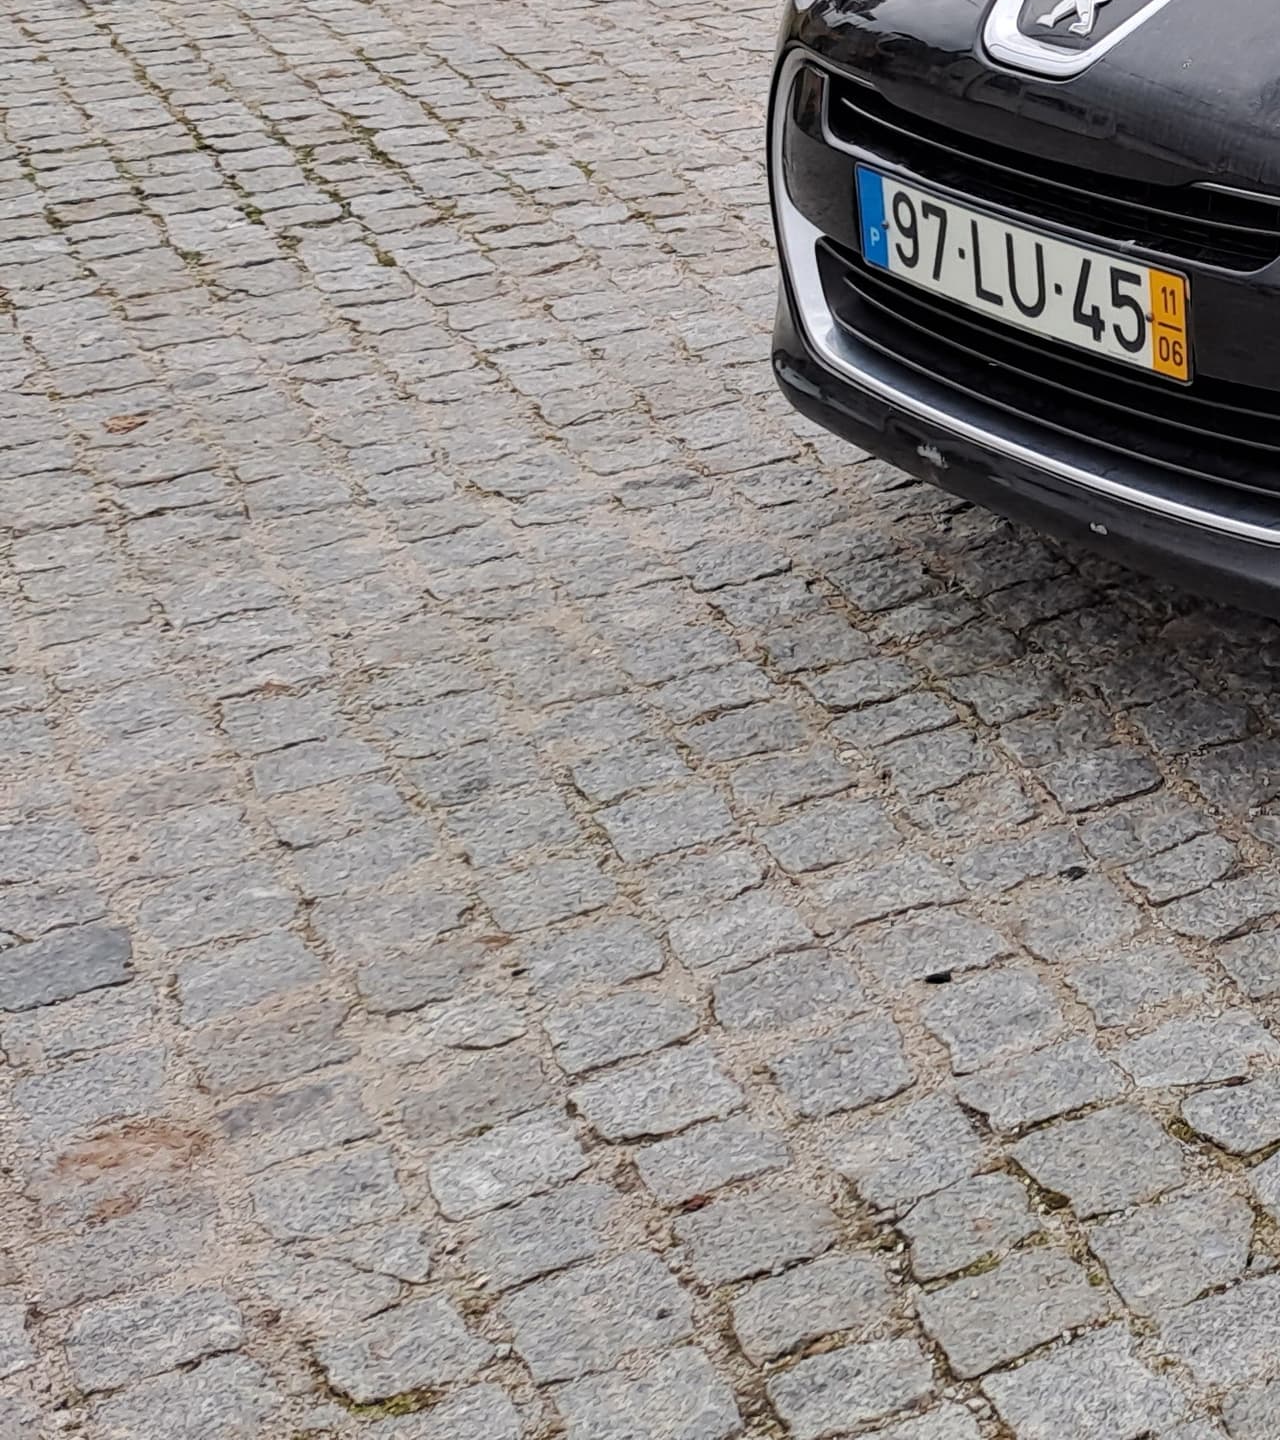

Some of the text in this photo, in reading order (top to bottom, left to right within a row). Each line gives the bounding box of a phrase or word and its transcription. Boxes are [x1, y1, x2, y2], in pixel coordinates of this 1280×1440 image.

[870, 226, 880, 247] P
[1161, 286, 1178, 316] 11
[1159, 336, 1184, 366] 06
